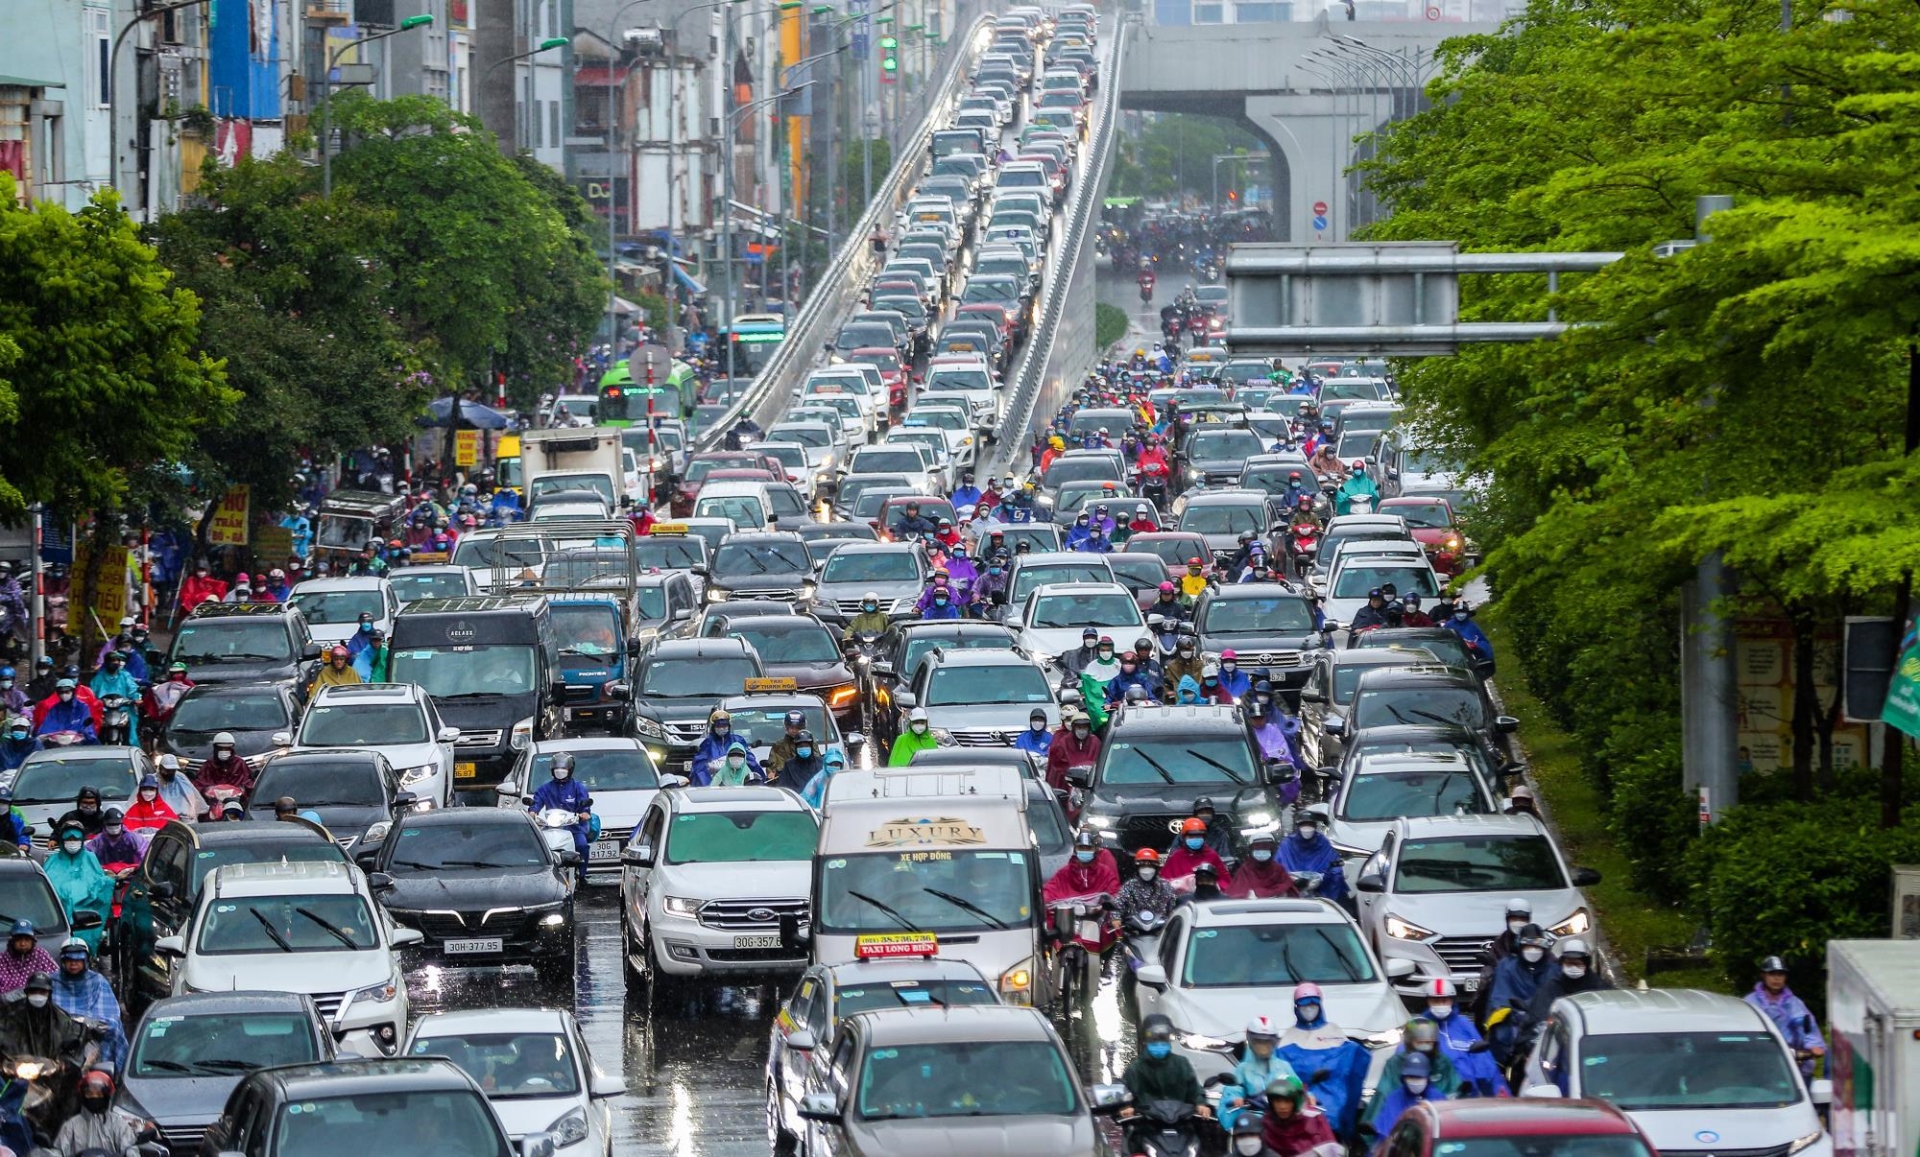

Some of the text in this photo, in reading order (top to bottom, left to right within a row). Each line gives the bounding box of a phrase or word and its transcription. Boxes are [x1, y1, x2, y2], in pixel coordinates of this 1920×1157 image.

[869, 826, 982, 841] LUXURY
[913, 854, 928, 863] HỢP
[450, 942, 498, 951] 30H-377.95
[736, 936, 782, 947] 30G-357.6
[862, 946, 884, 954] TAXI
[912, 943, 934, 952] BIÊN
